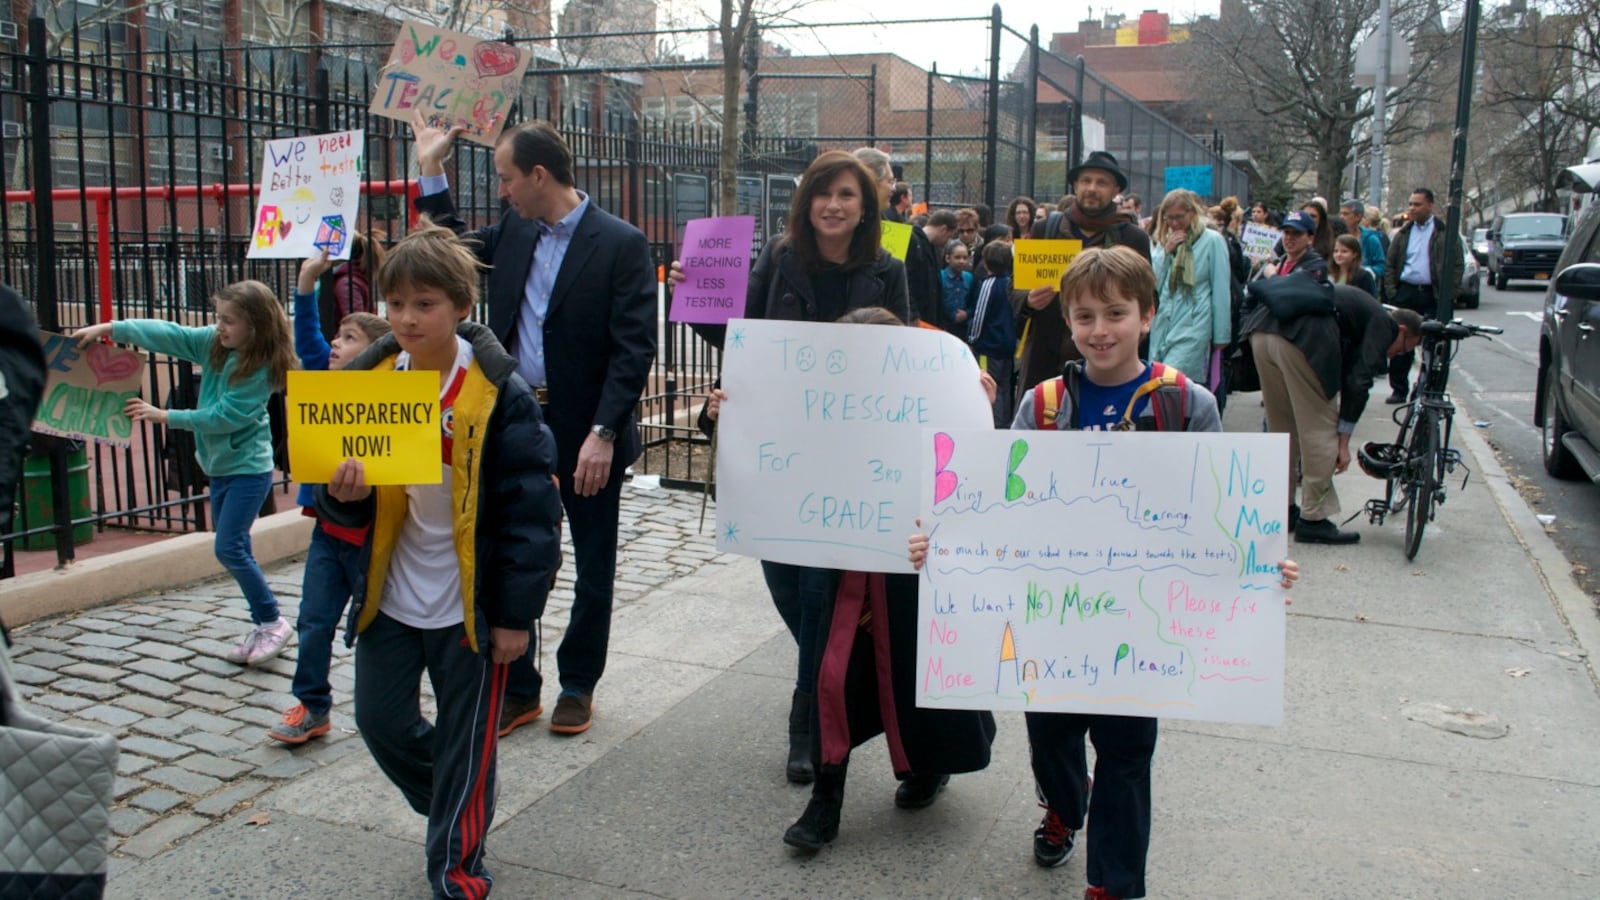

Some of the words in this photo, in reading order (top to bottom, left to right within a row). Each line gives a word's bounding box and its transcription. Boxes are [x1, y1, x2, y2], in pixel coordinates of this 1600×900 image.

[409, 26, 457, 60] We
[269, 141, 305, 167] We
[319, 134, 351, 154] need
[698, 238, 732, 249] MORE
[684, 256, 742, 268] TEACHING
[1018, 253, 1076, 265] TRANSPARENC
[696, 278, 725, 290] LESS
[1036, 269, 1059, 279] NOW!
[684, 296, 734, 308] TESTING
[882, 338, 956, 375] Much
[298, 402, 433, 425] TRANSPARENCY
[342, 435, 391, 457] NOW!
[758, 442, 800, 472] For
[933, 431, 983, 512] Bring
[1086, 443, 1137, 489] True
[1228, 449, 1265, 498] No
[798, 492, 894, 533] GRADE
[1234, 505, 1281, 538] More
[956, 541, 989, 556] much
[996, 544, 1009, 562] of
[1180, 547, 1198, 559] the
[934, 589, 957, 614] We
[1168, 579, 1221, 613] Please
[929, 617, 958, 645] No
[1169, 618, 1216, 640] these
[924, 655, 976, 693] More
[1113, 643, 1184, 677] Please!
